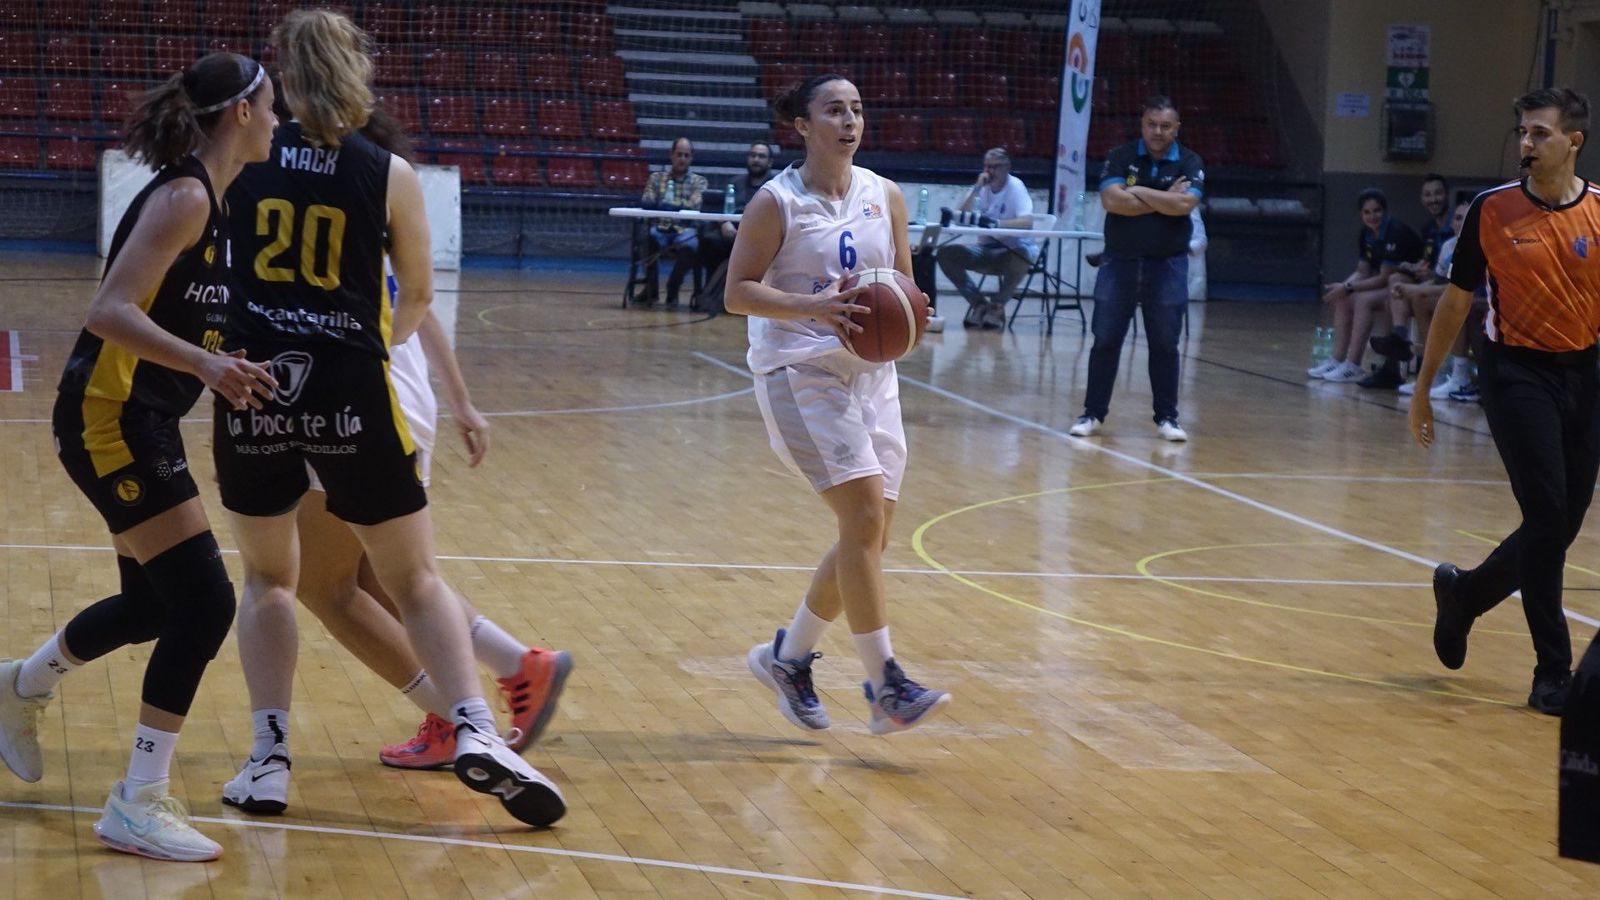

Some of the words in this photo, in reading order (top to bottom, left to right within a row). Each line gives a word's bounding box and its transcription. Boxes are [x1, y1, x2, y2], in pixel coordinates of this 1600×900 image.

[280, 146, 339, 175] MACK
[254, 197, 346, 291] 20
[838, 230, 857, 271] 6
[226, 411, 243, 437] la
[300, 412, 327, 438] te
[335, 405, 363, 438] lía
[260, 442, 289, 455] QUE
[136, 736, 155, 753] 23
